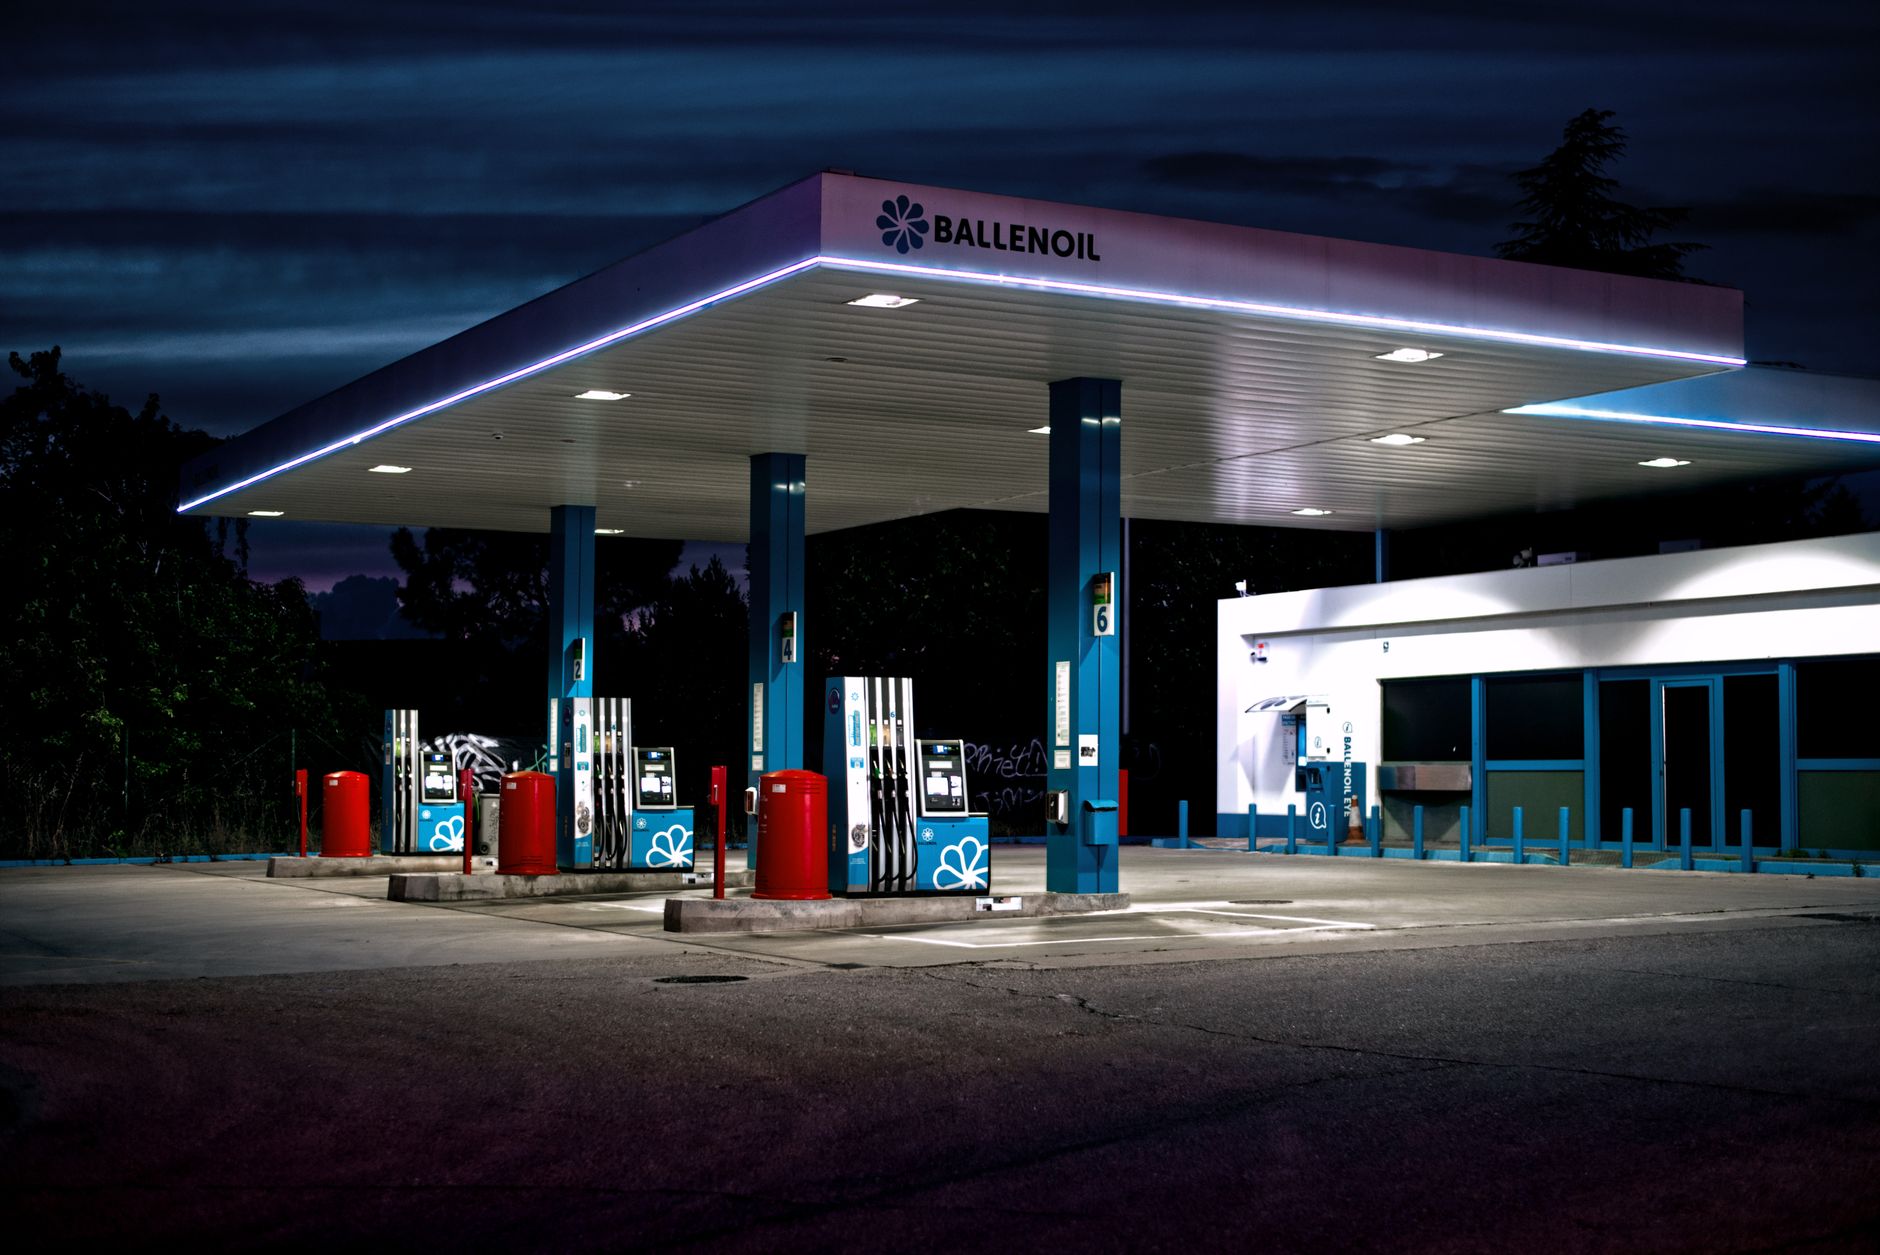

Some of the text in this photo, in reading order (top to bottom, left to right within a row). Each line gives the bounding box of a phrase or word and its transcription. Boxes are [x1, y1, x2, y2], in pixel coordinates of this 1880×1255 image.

[934, 215, 1100, 261] BALLENOIL
[1097, 606, 1107, 632] 6
[784, 639, 792, 660] 4
[575, 661, 581, 679] 2
